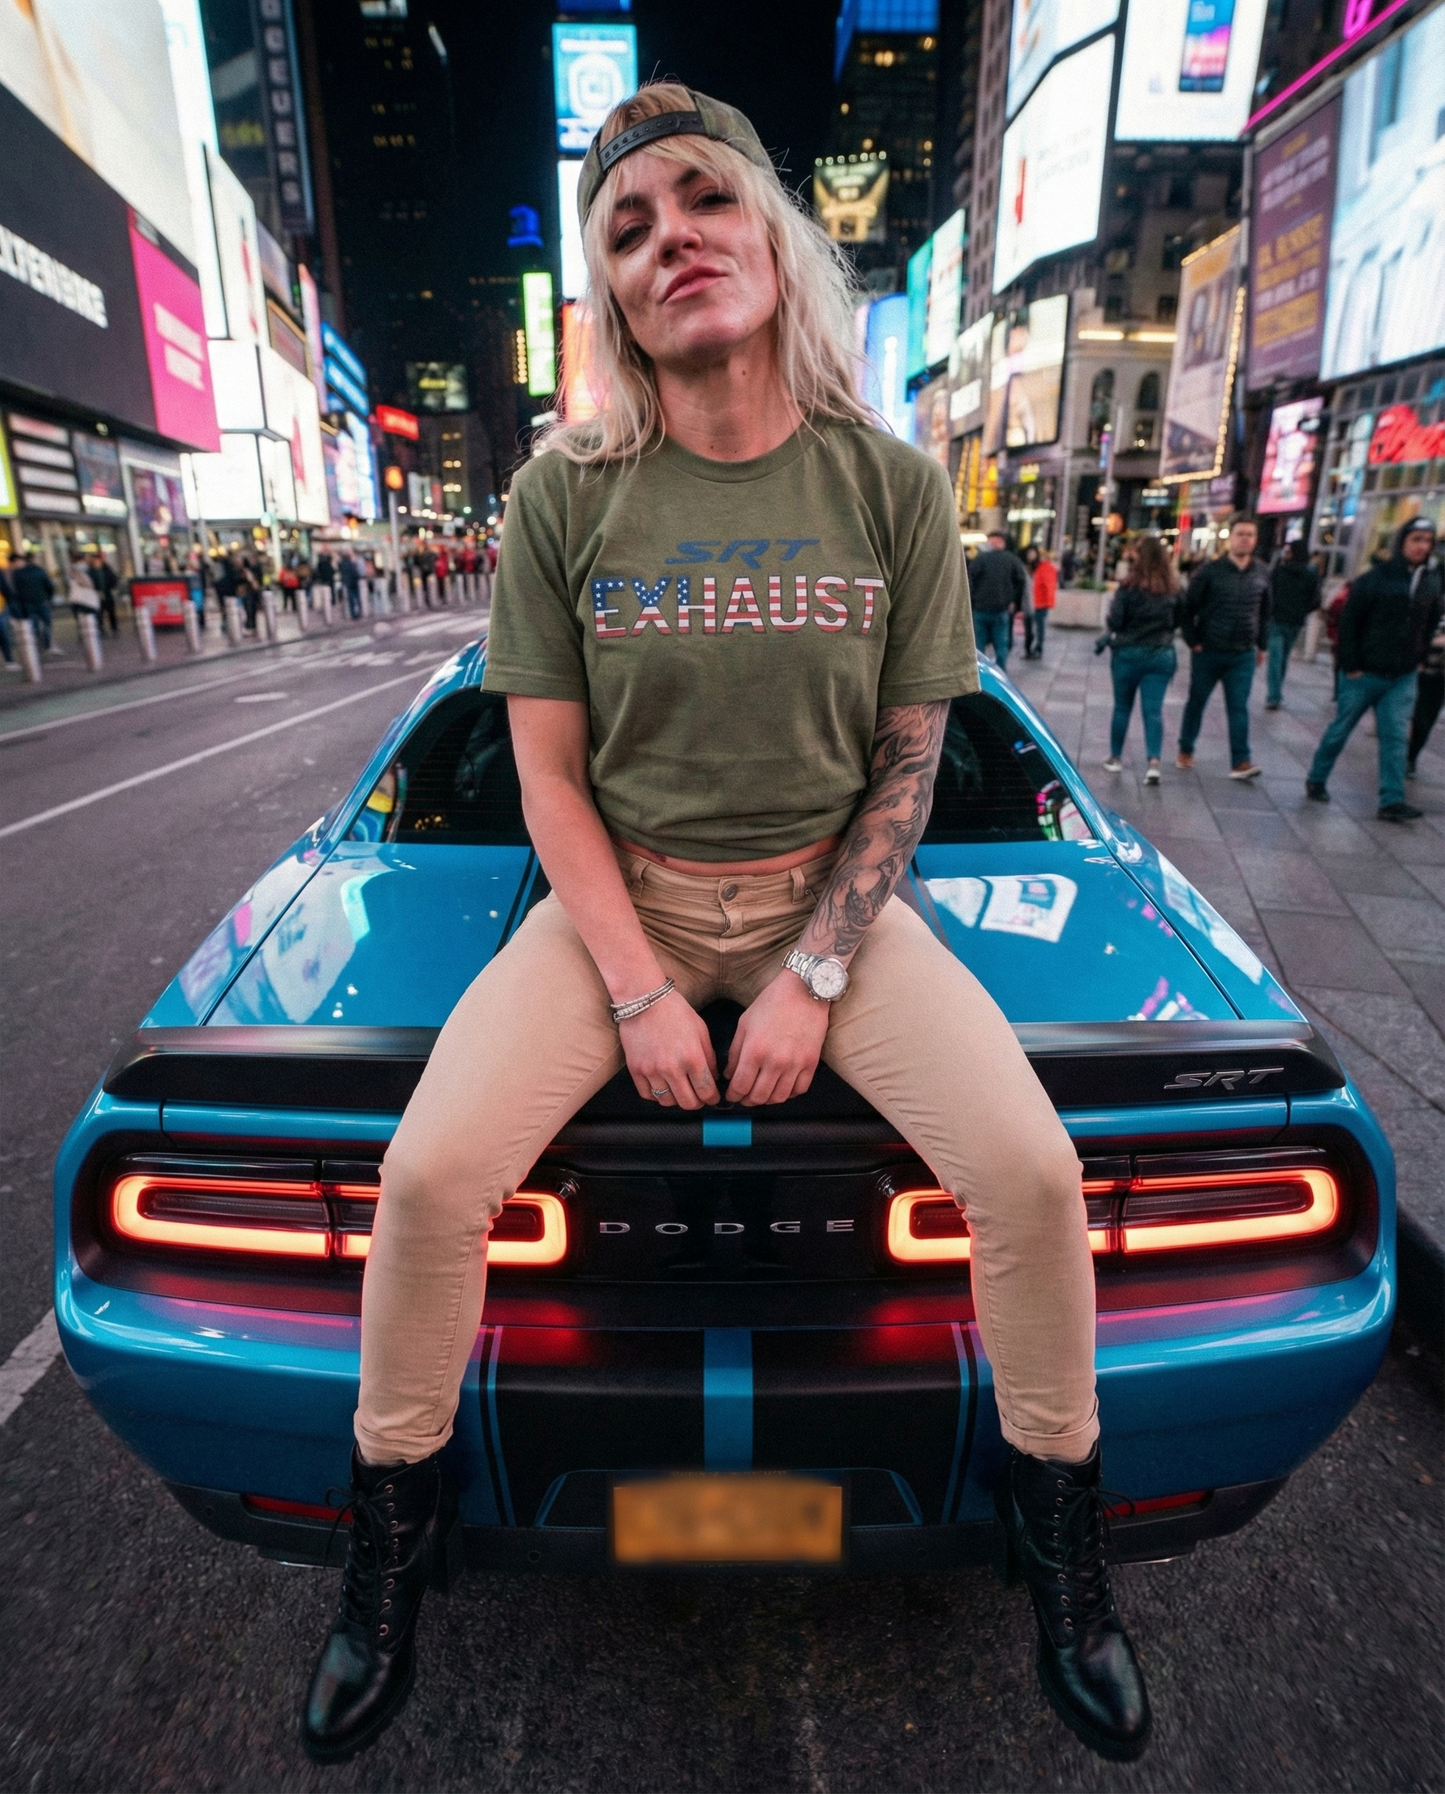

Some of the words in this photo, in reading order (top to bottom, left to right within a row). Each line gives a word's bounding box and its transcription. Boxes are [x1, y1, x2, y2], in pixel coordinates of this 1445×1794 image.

[664, 538, 820, 570] SRT
[590, 574, 885, 639] EXHAUST
[1163, 1066, 1285, 1091] SRT
[599, 1219, 854, 1235] DODGE
